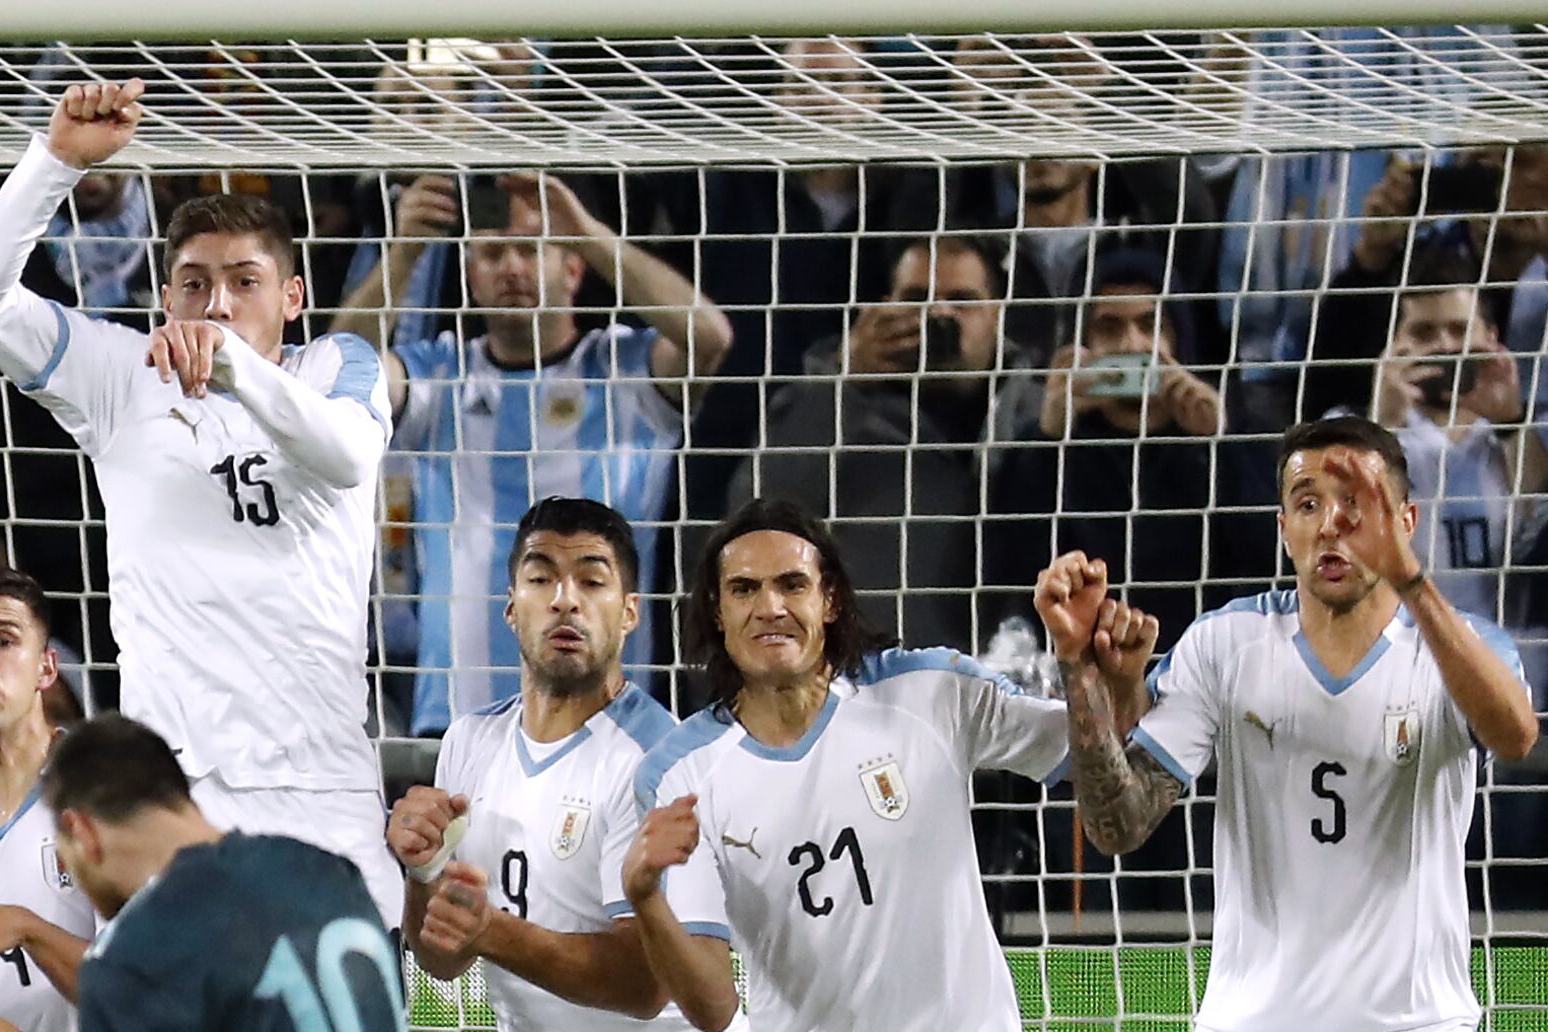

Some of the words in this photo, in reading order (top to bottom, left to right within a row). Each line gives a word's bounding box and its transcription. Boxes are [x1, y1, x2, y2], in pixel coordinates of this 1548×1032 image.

[210, 454, 280, 526] 15
[1443, 516, 1491, 568] 10
[1311, 761, 1347, 844] 5
[501, 848, 528, 920] 9
[788, 826, 874, 917] 21
